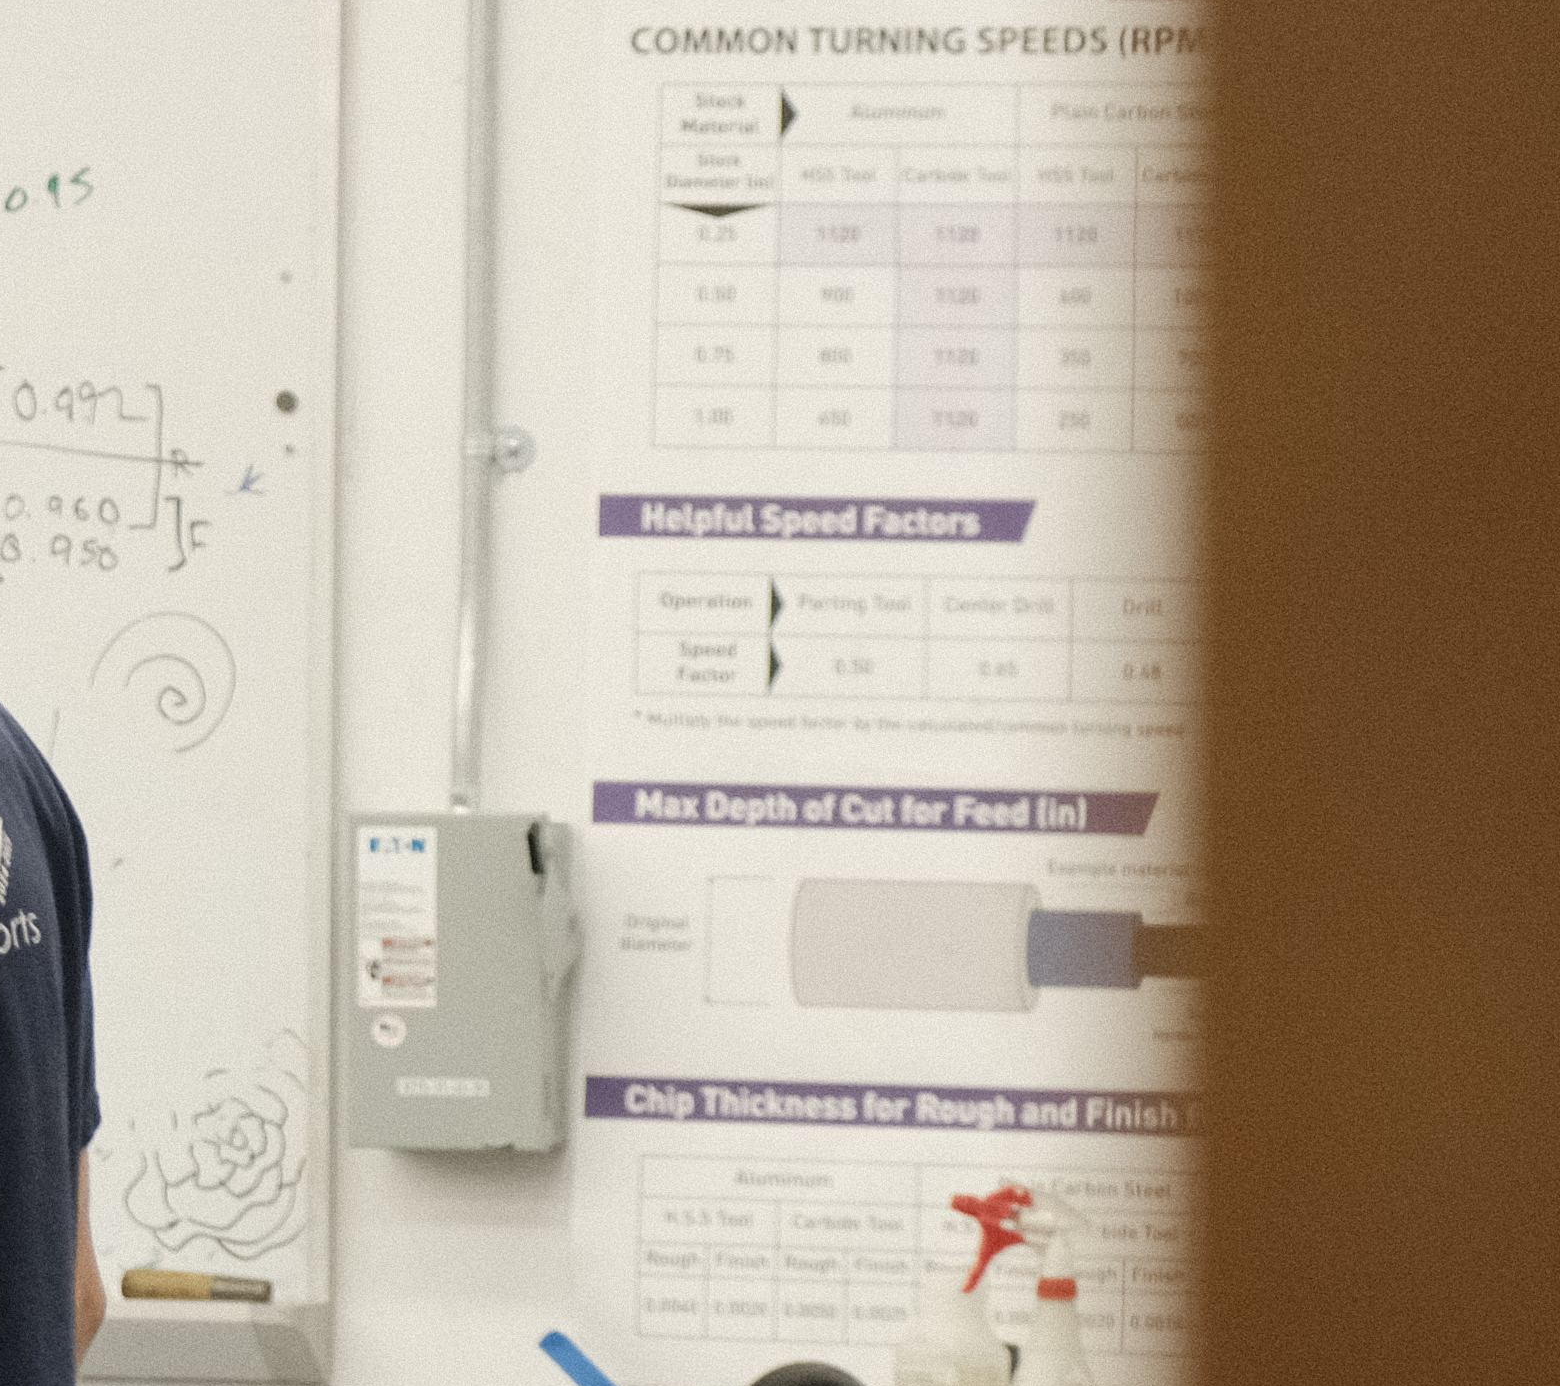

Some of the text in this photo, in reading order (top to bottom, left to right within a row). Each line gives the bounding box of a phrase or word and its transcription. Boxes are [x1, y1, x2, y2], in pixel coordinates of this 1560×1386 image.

[629, 25, 798, 56] COMMON
[808, 25, 967, 56] TURNING
[976, 25, 1109, 56] SPEEDS
[4, 165, 95, 215] 0.95
[2, 494, 121, 528] 0.960
[640, 502, 981, 539] Helpful Speed Factors
[634, 789, 1089, 831] Max Depth of Cut for Feed (in)
[624, 1085, 1180, 1131] Chip Thickness for Rough and Finish
